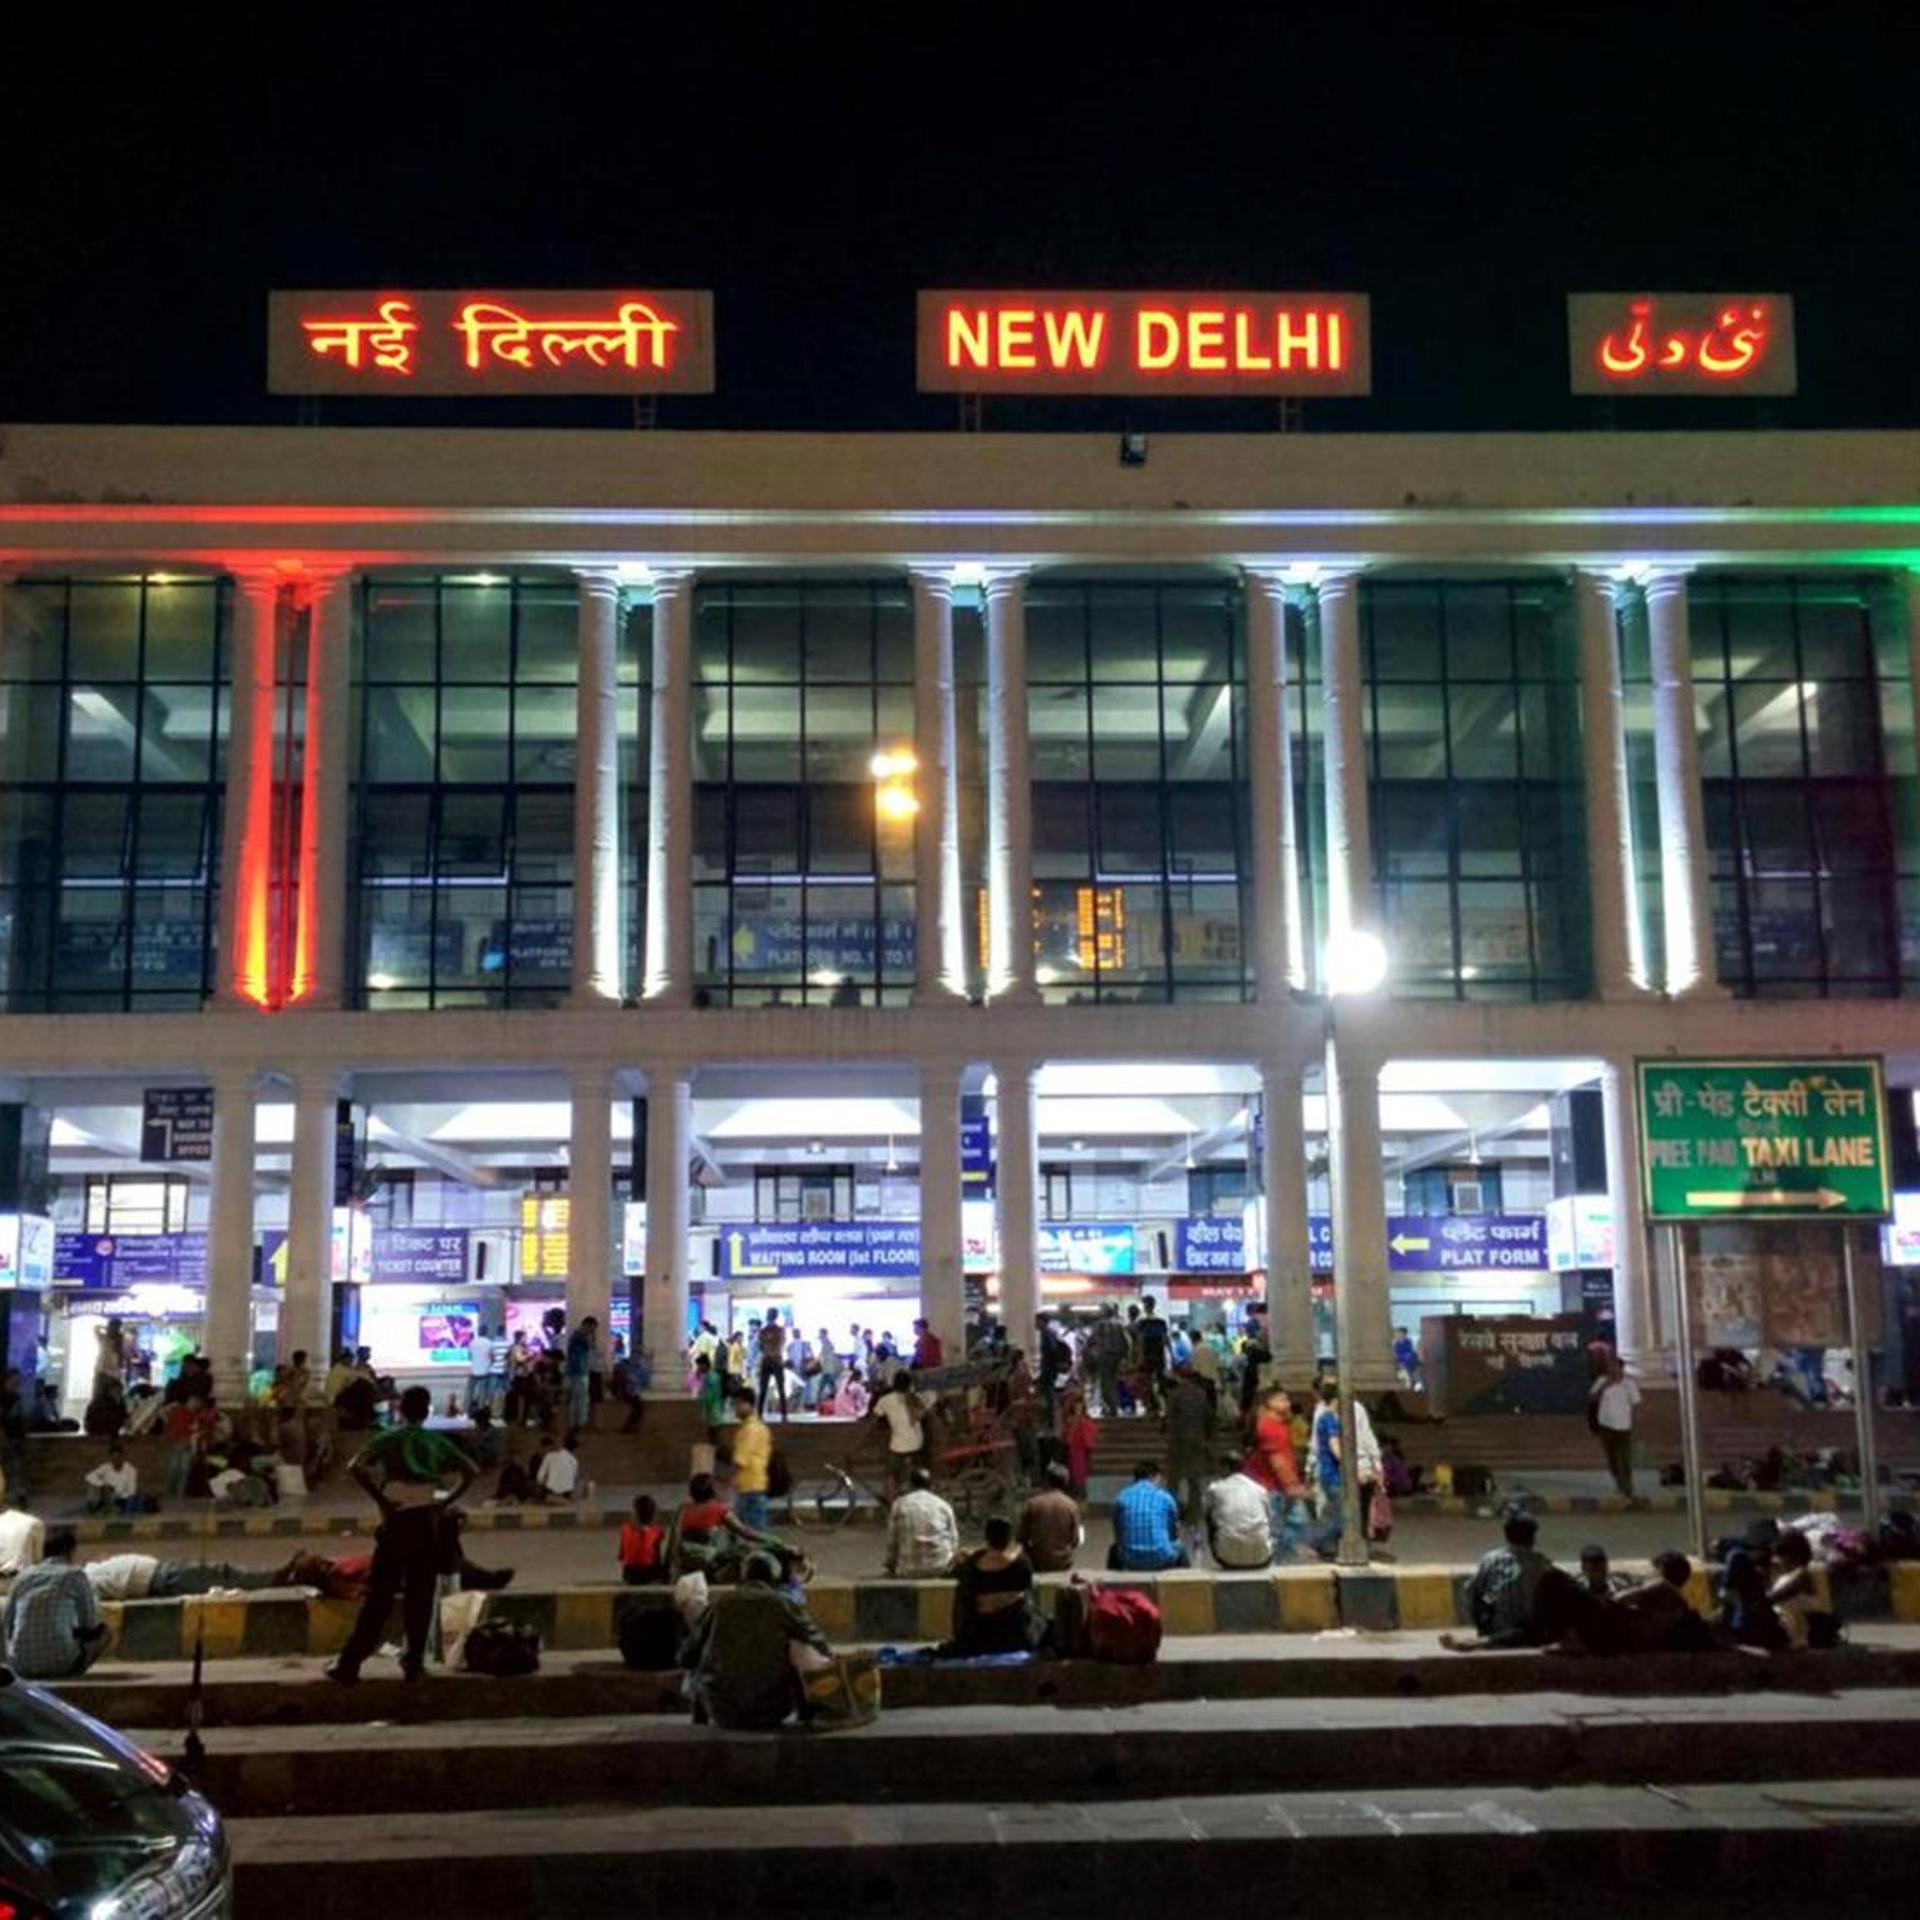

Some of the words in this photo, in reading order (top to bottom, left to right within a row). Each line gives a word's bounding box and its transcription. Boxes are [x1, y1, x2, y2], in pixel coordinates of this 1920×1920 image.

[303, 300, 418, 373] नई
[454, 302, 678, 369] दिल्ली
[947, 309, 1105, 368] NEW
[1137, 310, 1342, 370] DELHI
[1742, 1078, 1807, 1117] टैक्सी
[1822, 1080, 1865, 1117] लेन
[1742, 1136, 1800, 1167] TAXI
[1805, 1136, 1874, 1167] LANE
[414, 1259, 462, 1273] COUNTER
[750, 1249, 805, 1265] WAITING
[807, 1249, 846, 1265] ROOM
[872, 1248, 920, 1267] FLOOR)
[1441, 1249, 1485, 1265] PLAT
[1489, 1249, 1540, 1265] FORM
